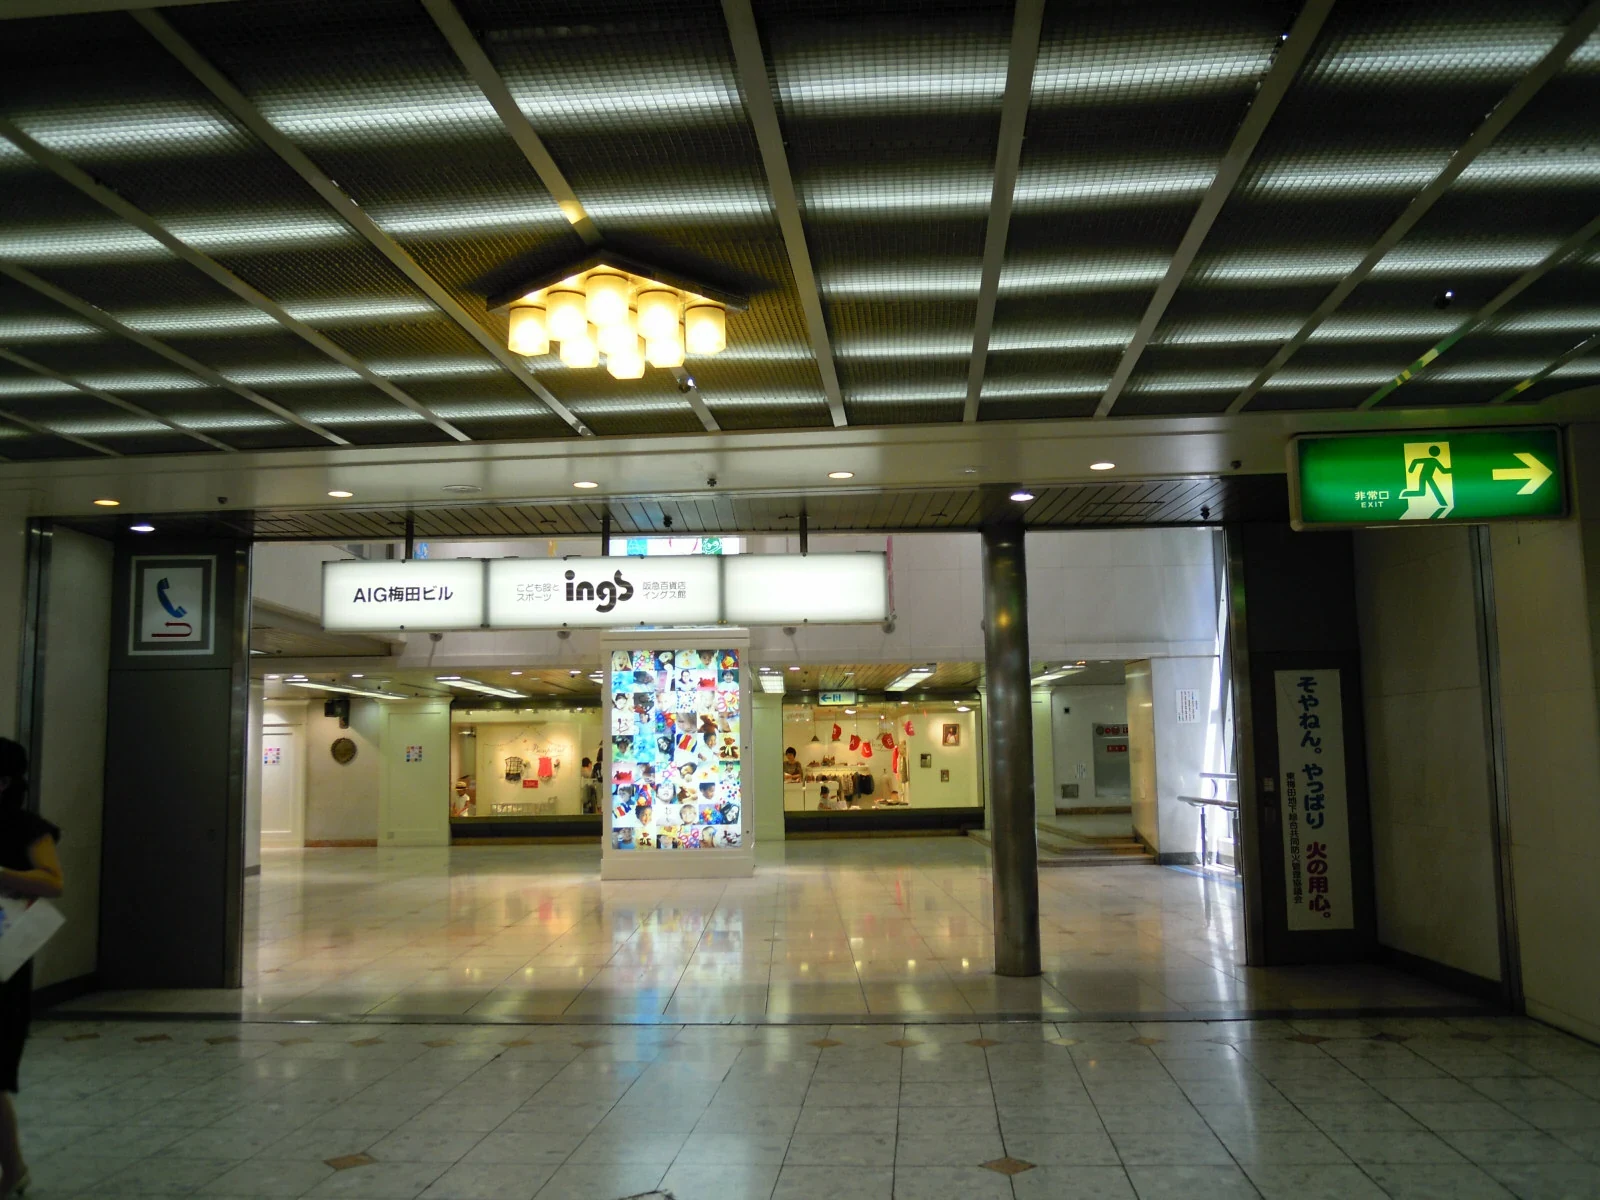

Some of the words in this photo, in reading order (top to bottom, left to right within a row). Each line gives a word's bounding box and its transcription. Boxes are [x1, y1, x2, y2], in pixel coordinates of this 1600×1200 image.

[1354, 490, 1389, 500] 非常口
[564, 569, 634, 613] ings
[642, 581, 687, 591] 阪急百貨店
[353, 586, 454, 603] AIG梅田ビル
[516, 593, 552, 602] スポーツ
[643, 590, 687, 600] イングス館
[1301, 763, 1326, 829] やっぱり
[1305, 841, 1331, 918] 火の用心。
